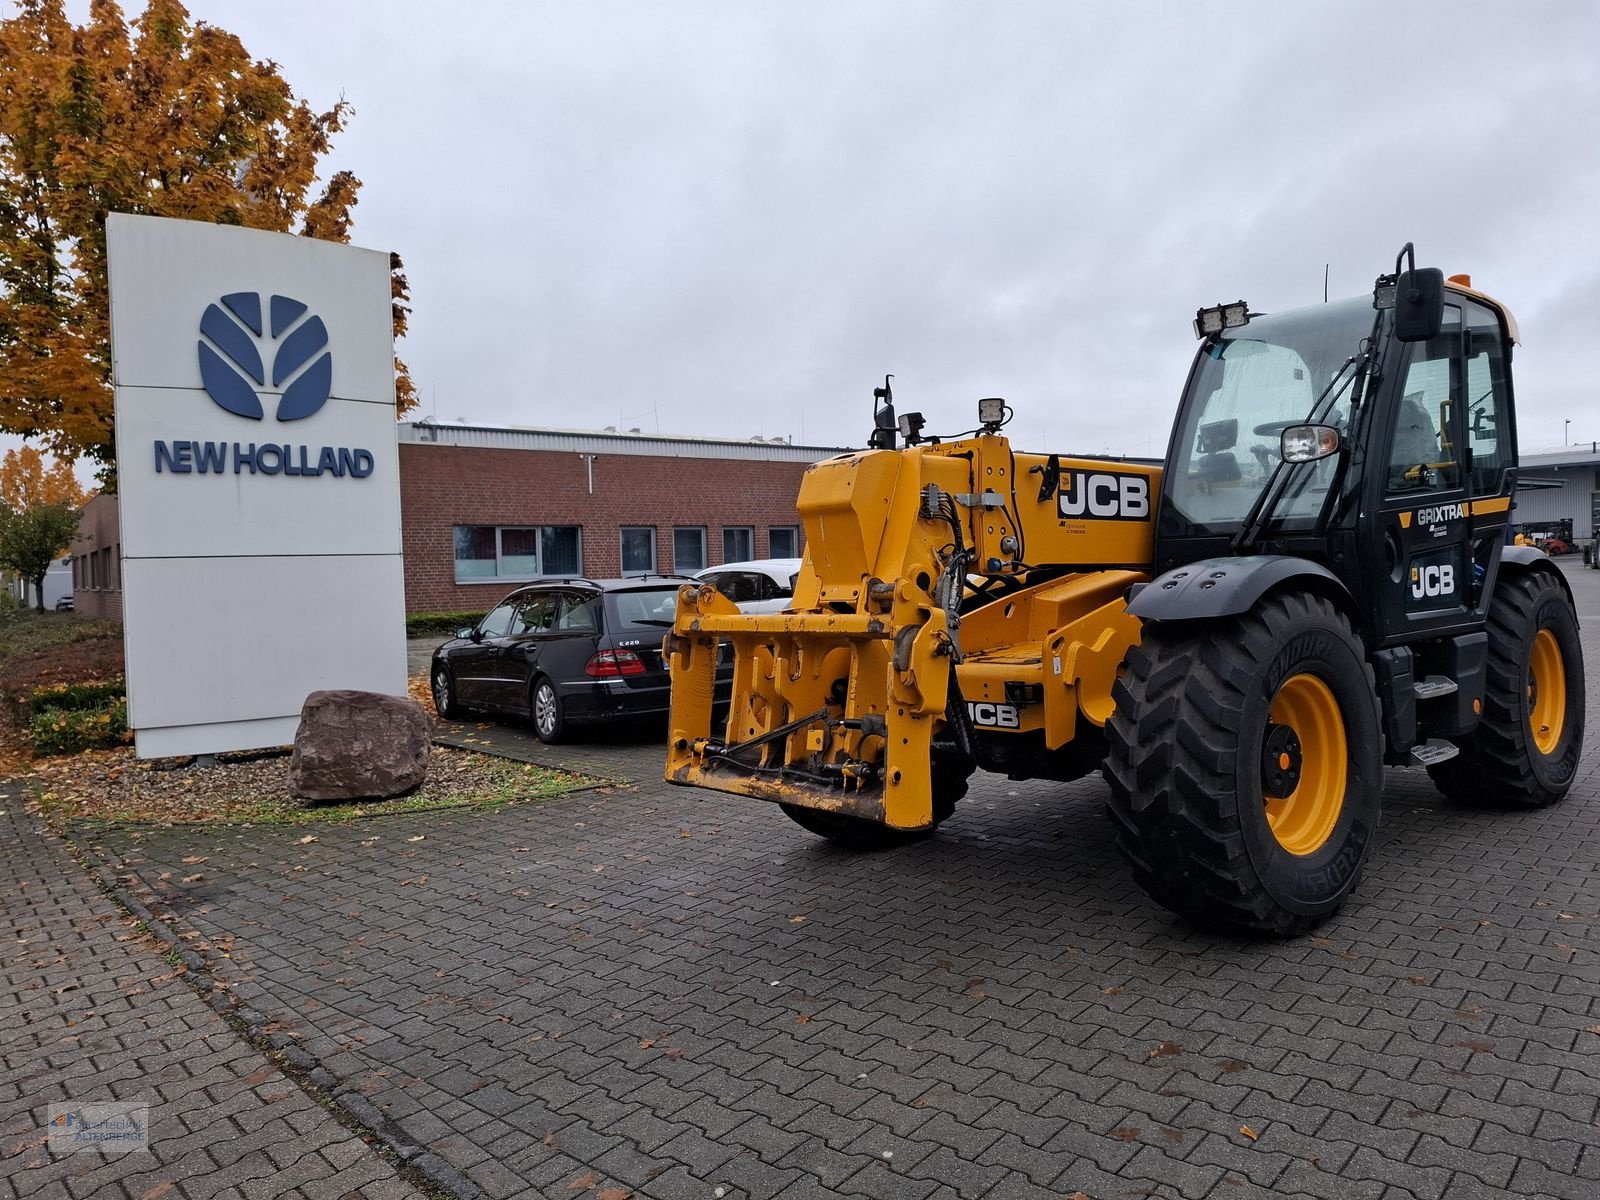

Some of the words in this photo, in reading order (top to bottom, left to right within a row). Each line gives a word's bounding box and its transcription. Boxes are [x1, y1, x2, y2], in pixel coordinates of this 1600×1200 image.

[154, 440, 226, 474] NEW
[234, 442, 374, 478] HOLLAND
[1060, 473, 1149, 518] JCB
[1412, 564, 1455, 599] JCB
